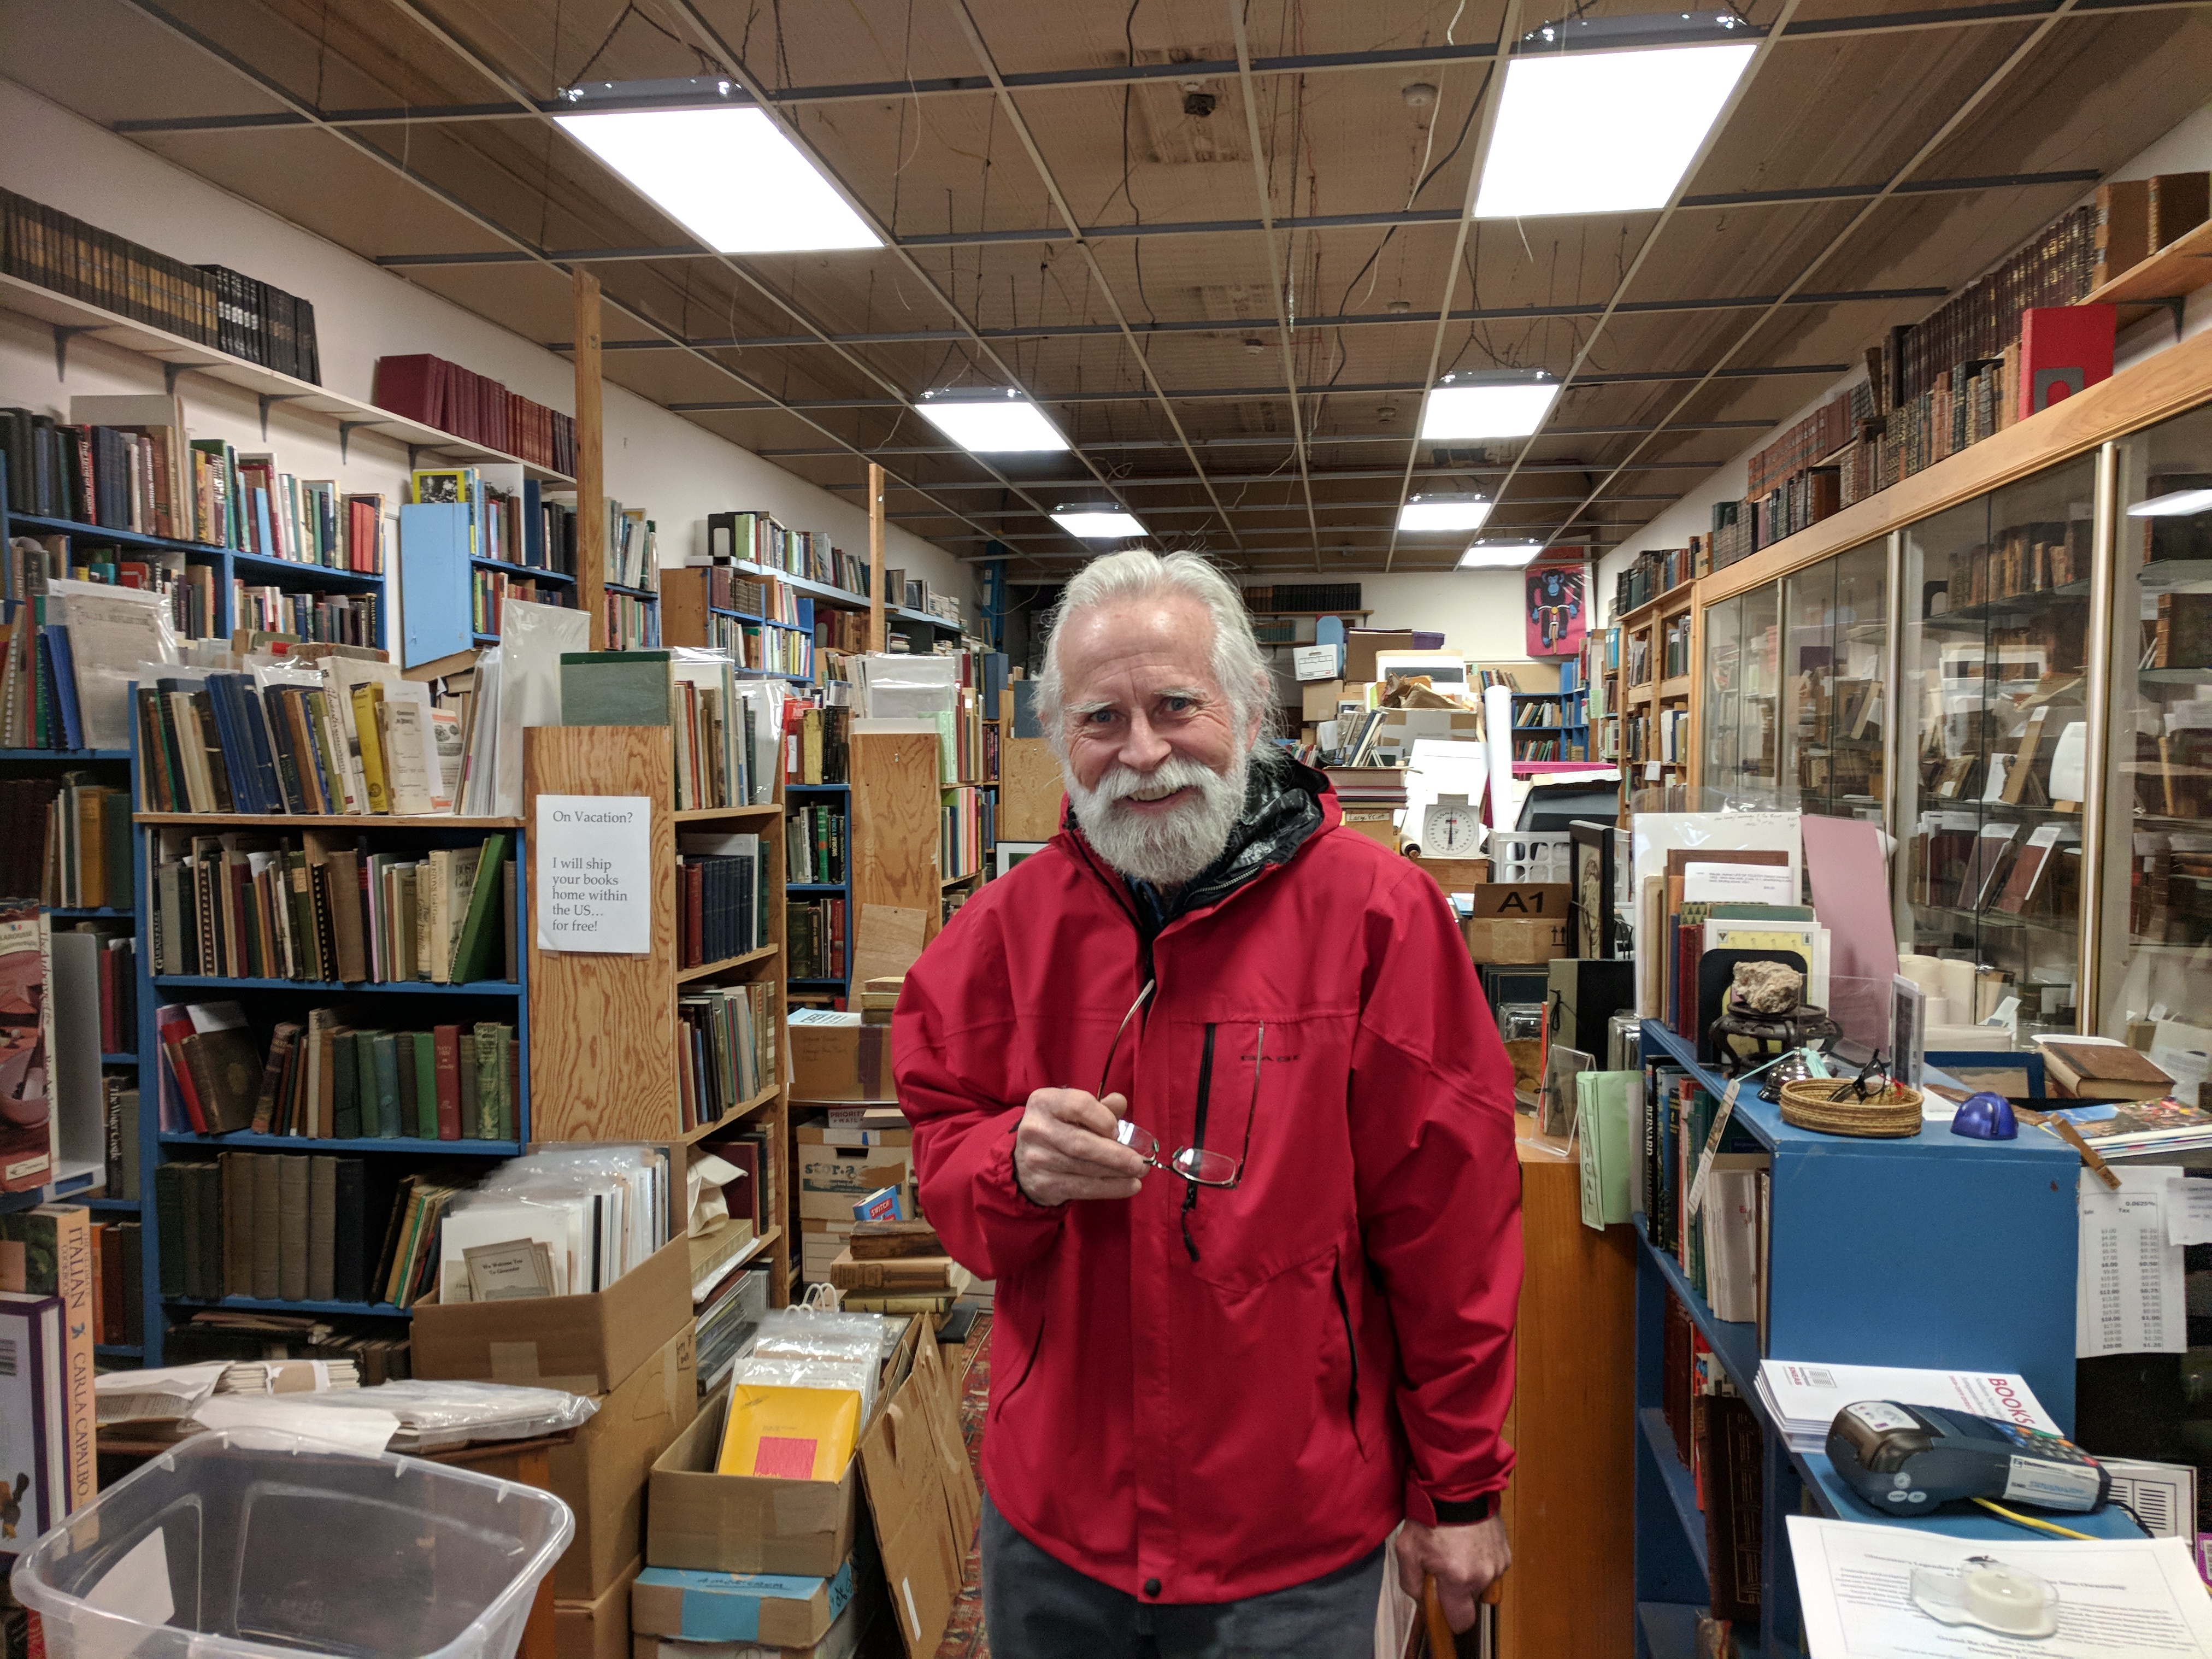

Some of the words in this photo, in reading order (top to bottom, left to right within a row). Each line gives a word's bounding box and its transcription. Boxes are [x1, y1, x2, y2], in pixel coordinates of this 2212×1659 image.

[553, 811, 570, 822] On
[575, 811, 633, 822] Vacation?
[552, 857, 557, 868] I
[561, 858, 583, 869] will
[586, 858, 611, 873] ship
[552, 876, 580, 886] your
[584, 874, 619, 885] books
[552, 886, 585, 899] home
[589, 889, 628, 901] within
[1497, 891, 1543, 913] A1
[552, 903, 570, 915] the
[574, 904, 603, 916] US...
[552, 919, 569, 931] for
[572, 920, 597, 931] free!
[870, 1199, 891, 1217] SWITCH
[68, 1226, 86, 1309] ITALIAN
[73, 1352, 87, 1414] CARLA
[1987, 1378, 2035, 1424] BOOKS
[74, 1417, 89, 1497] CAPALBO
